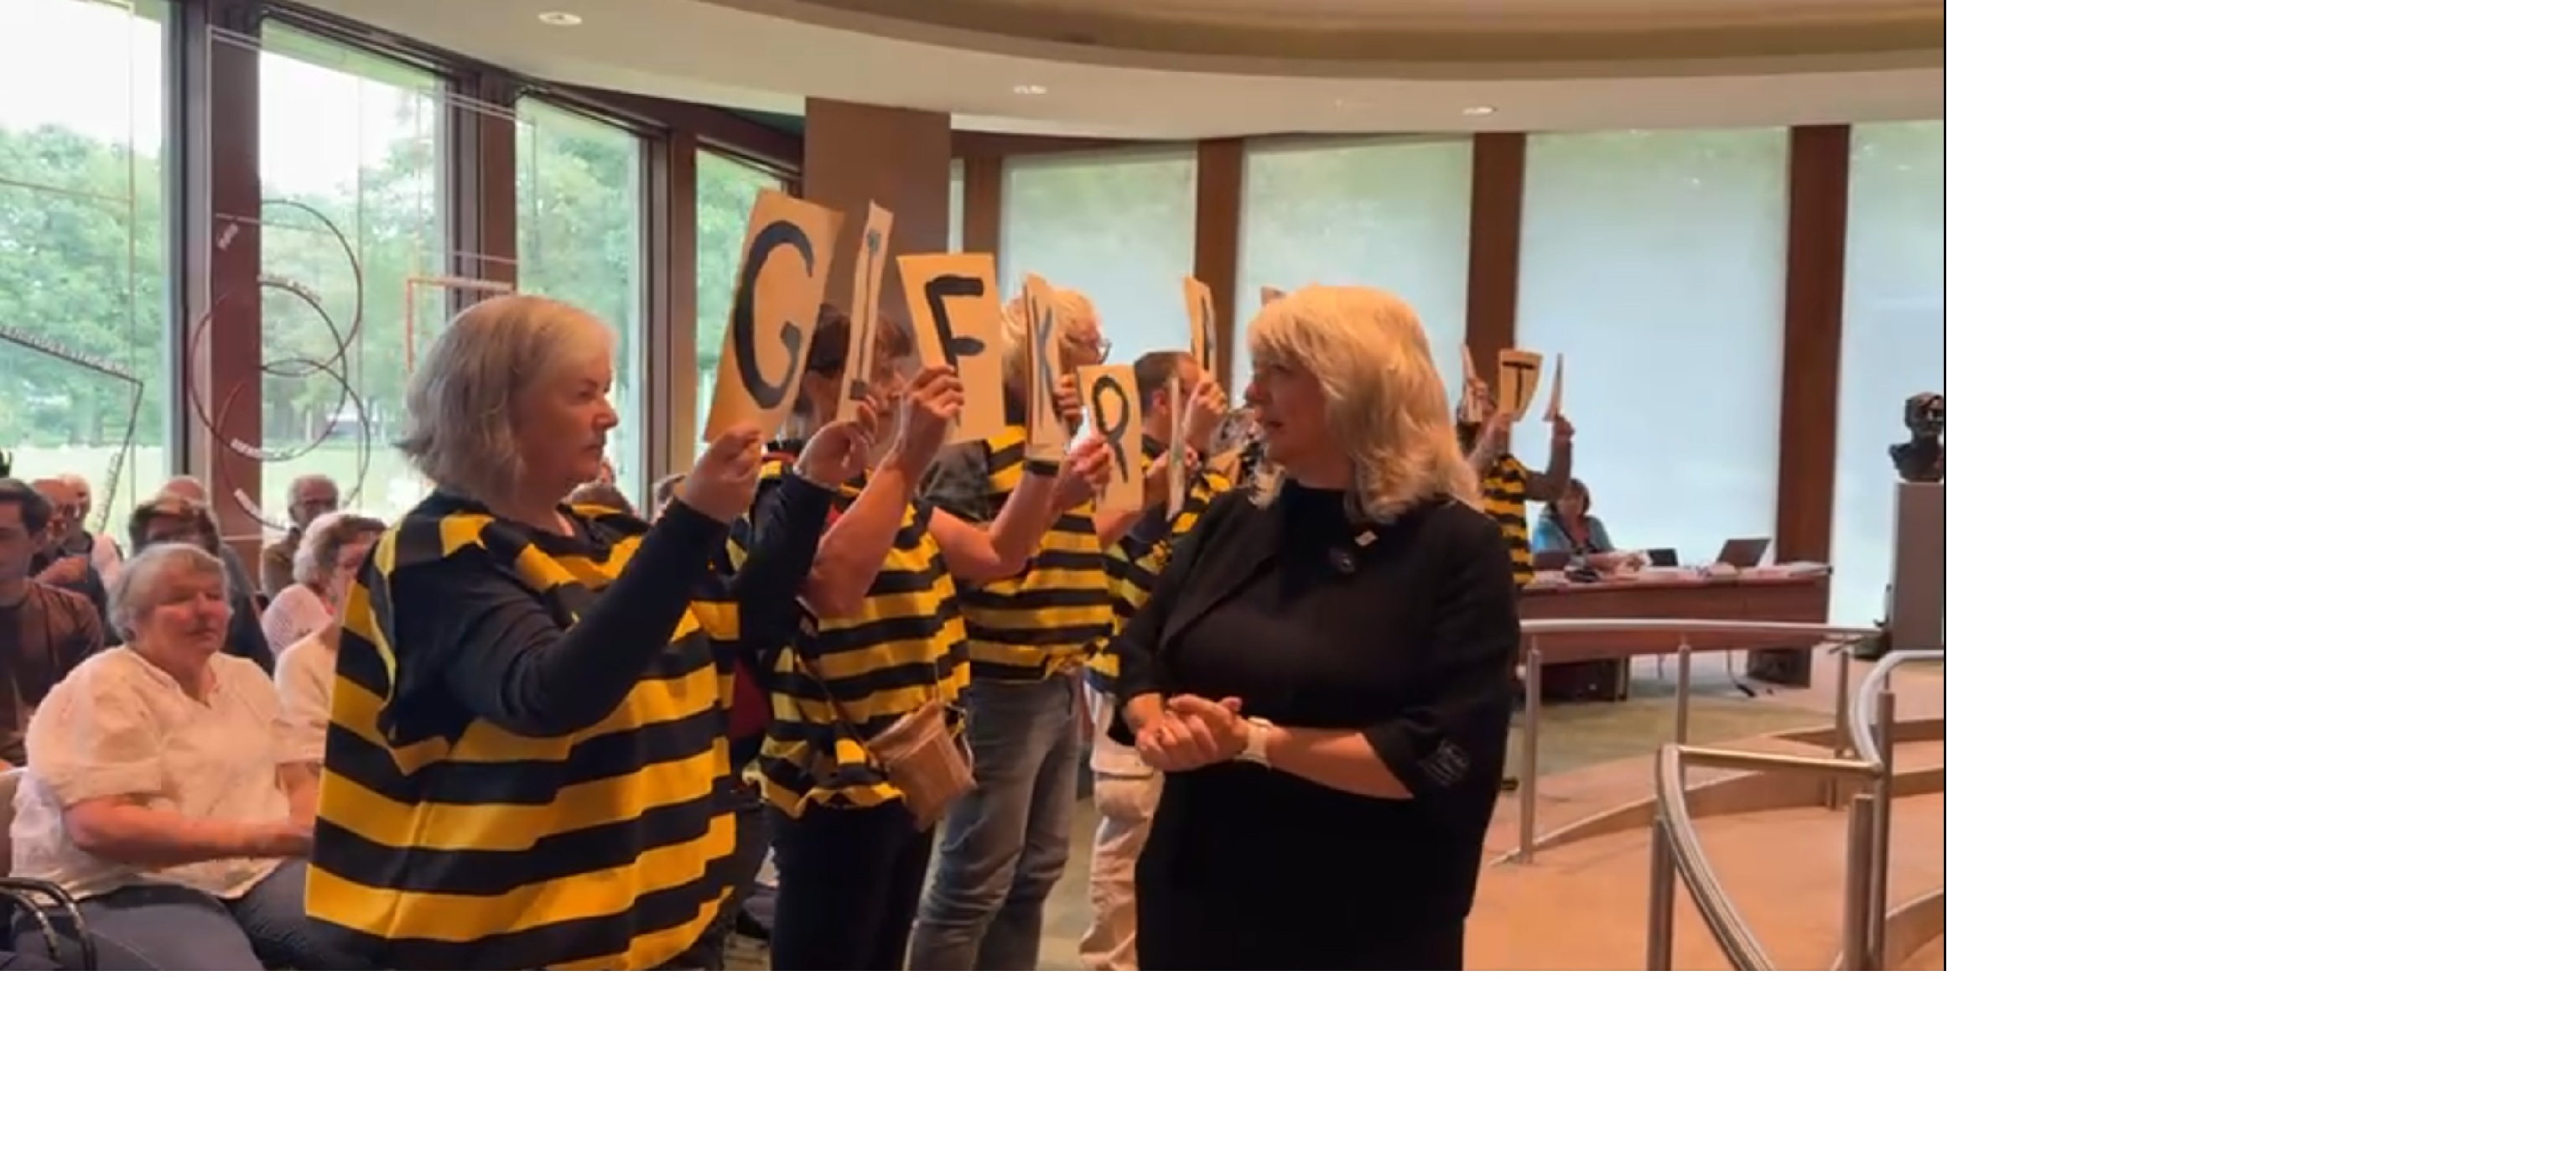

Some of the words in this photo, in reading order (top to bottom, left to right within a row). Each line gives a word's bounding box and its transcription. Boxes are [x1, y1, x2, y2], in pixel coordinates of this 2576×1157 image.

[734, 219, 814, 409] G
[849, 228, 880, 400] I
[925, 273, 984, 428] F
[1031, 295, 1062, 429] K
[1501, 361, 1538, 410] T
